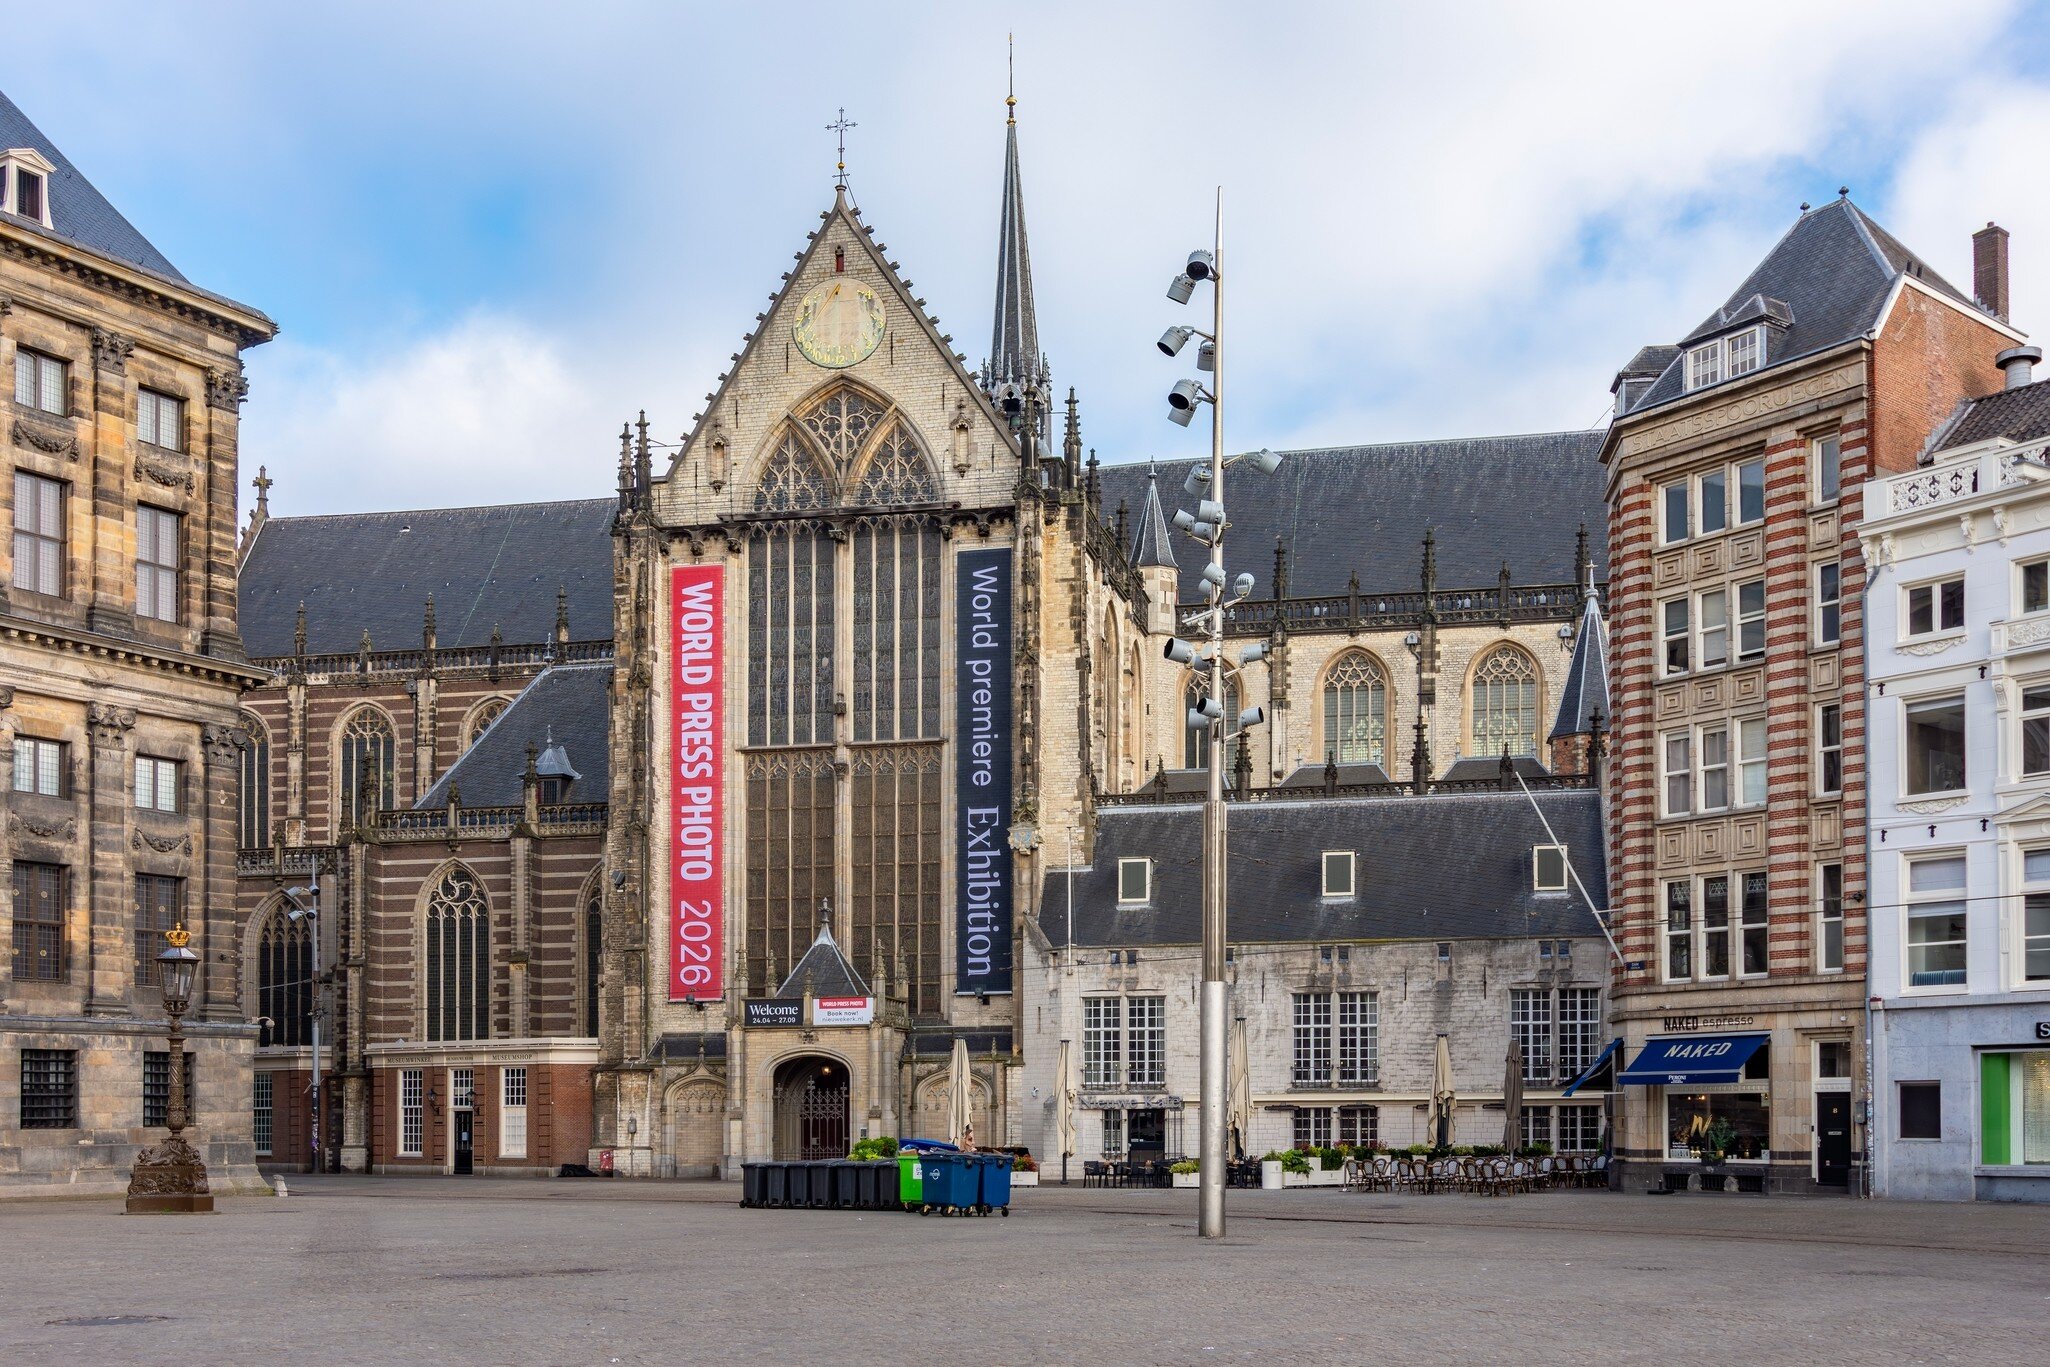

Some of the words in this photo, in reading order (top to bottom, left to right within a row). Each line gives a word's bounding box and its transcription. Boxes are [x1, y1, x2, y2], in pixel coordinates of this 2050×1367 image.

[804, 296, 810, 306] 6
[796, 316, 804, 328] 7
[878, 317, 884, 328] 3
[798, 332, 805, 342] 8
[804, 341, 812, 352] 9
[865, 340, 873, 350] 2
[810, 347, 822, 360] 10
[835, 355, 845, 365] 12
[972, 566, 998, 647] World
[681, 581, 713, 686] WORLD
[966, 660, 998, 786] premiere
[681, 693, 713, 778] PRESS
[681, 786, 713, 880] PHOTO
[968, 806, 1000, 976] Exhibition
[680, 900, 711, 985] 2026
[749, 1004, 798, 1016] Welcome
[1664, 1016, 1698, 1032] NAKED
[1702, 1016, 1754, 1029] espresso
[1664, 1042, 1732, 1058] NAKED
[1078, 1095, 1138, 1110] Nieuwe
